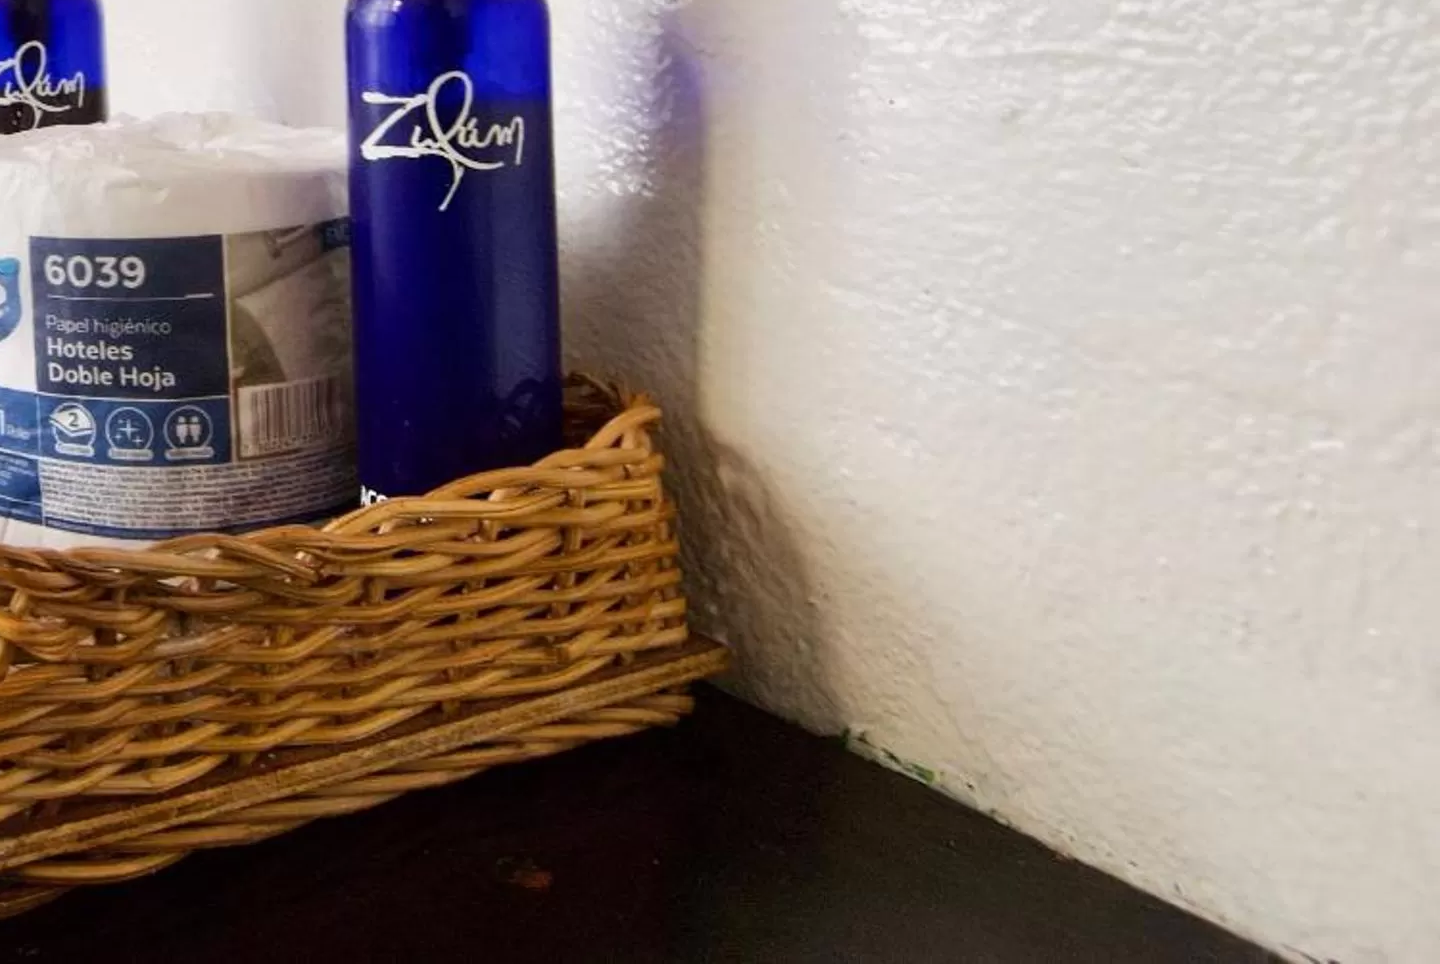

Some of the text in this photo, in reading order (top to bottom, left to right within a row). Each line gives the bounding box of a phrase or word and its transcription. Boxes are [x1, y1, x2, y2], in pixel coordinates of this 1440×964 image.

[44, 255, 147, 289] 6039
[45, 314, 172, 339] Papel higiénico
[46, 337, 134, 361] Hoteles
[47, 361, 177, 392] Doble Hoja
